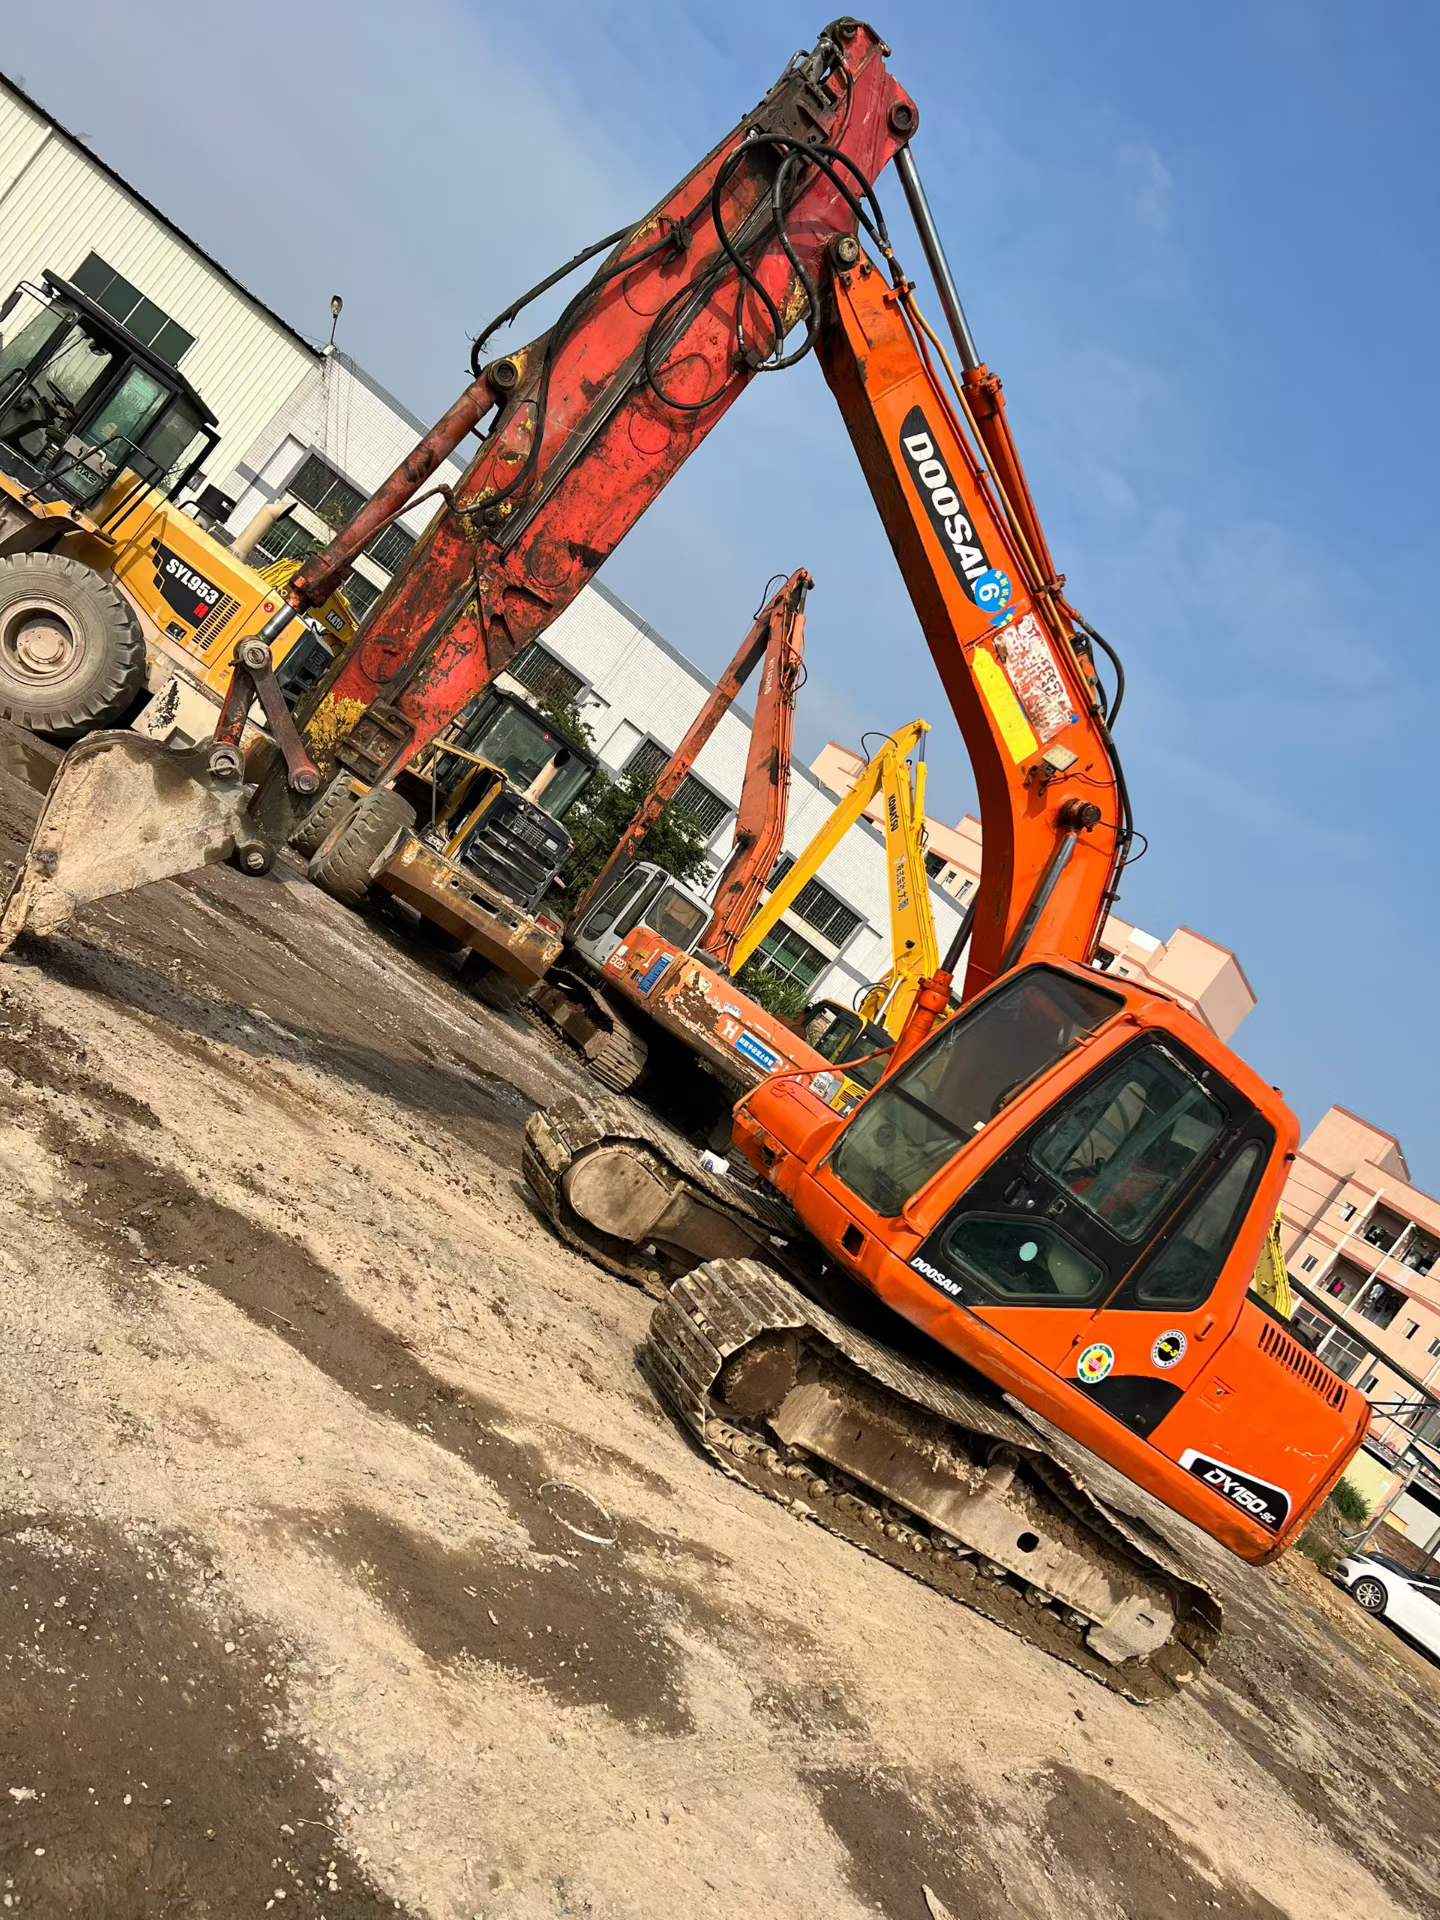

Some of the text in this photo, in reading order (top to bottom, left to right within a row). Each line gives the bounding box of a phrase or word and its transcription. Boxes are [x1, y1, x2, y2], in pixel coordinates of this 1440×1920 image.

[165, 558, 219, 605] SYL953
[978, 583, 1000, 602] 6
[326, 610, 343, 630] KATO
[887, 793, 899, 832] KOMATSU
[910, 1256, 963, 1296] DOOSAN
